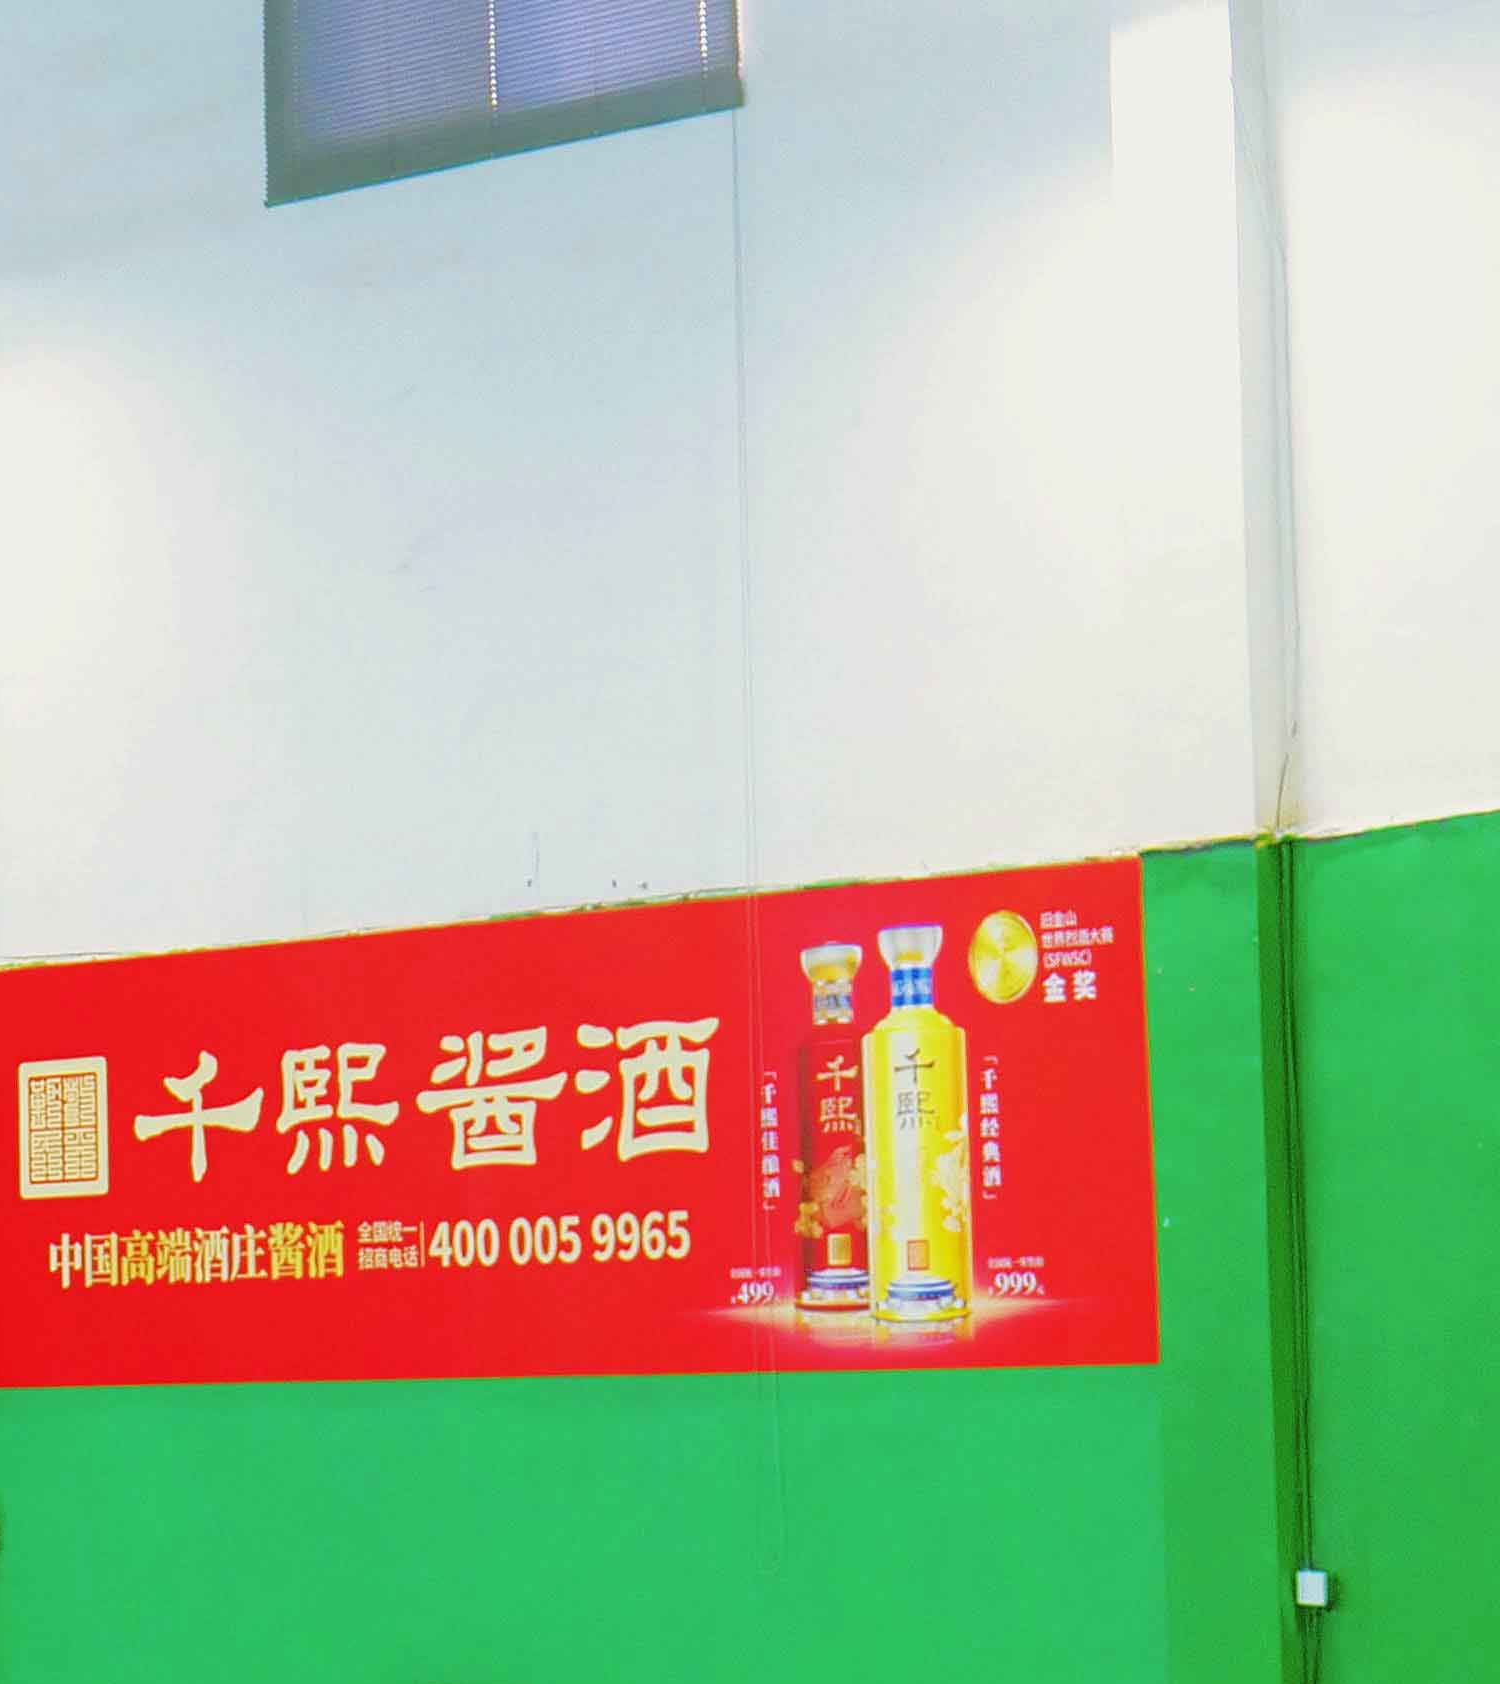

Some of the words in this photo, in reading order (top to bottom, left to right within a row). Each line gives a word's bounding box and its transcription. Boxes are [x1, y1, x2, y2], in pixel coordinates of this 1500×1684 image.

[1042, 970, 1097, 1003] 金奖
[134, 1017, 719, 1183] 千熙酱酒
[48, 1221, 345, 1289] 中国高端酒庄酱酒
[429, 1219, 500, 1268] 400
[509, 1216, 582, 1265] 005
[591, 1211, 692, 1262] 9965
